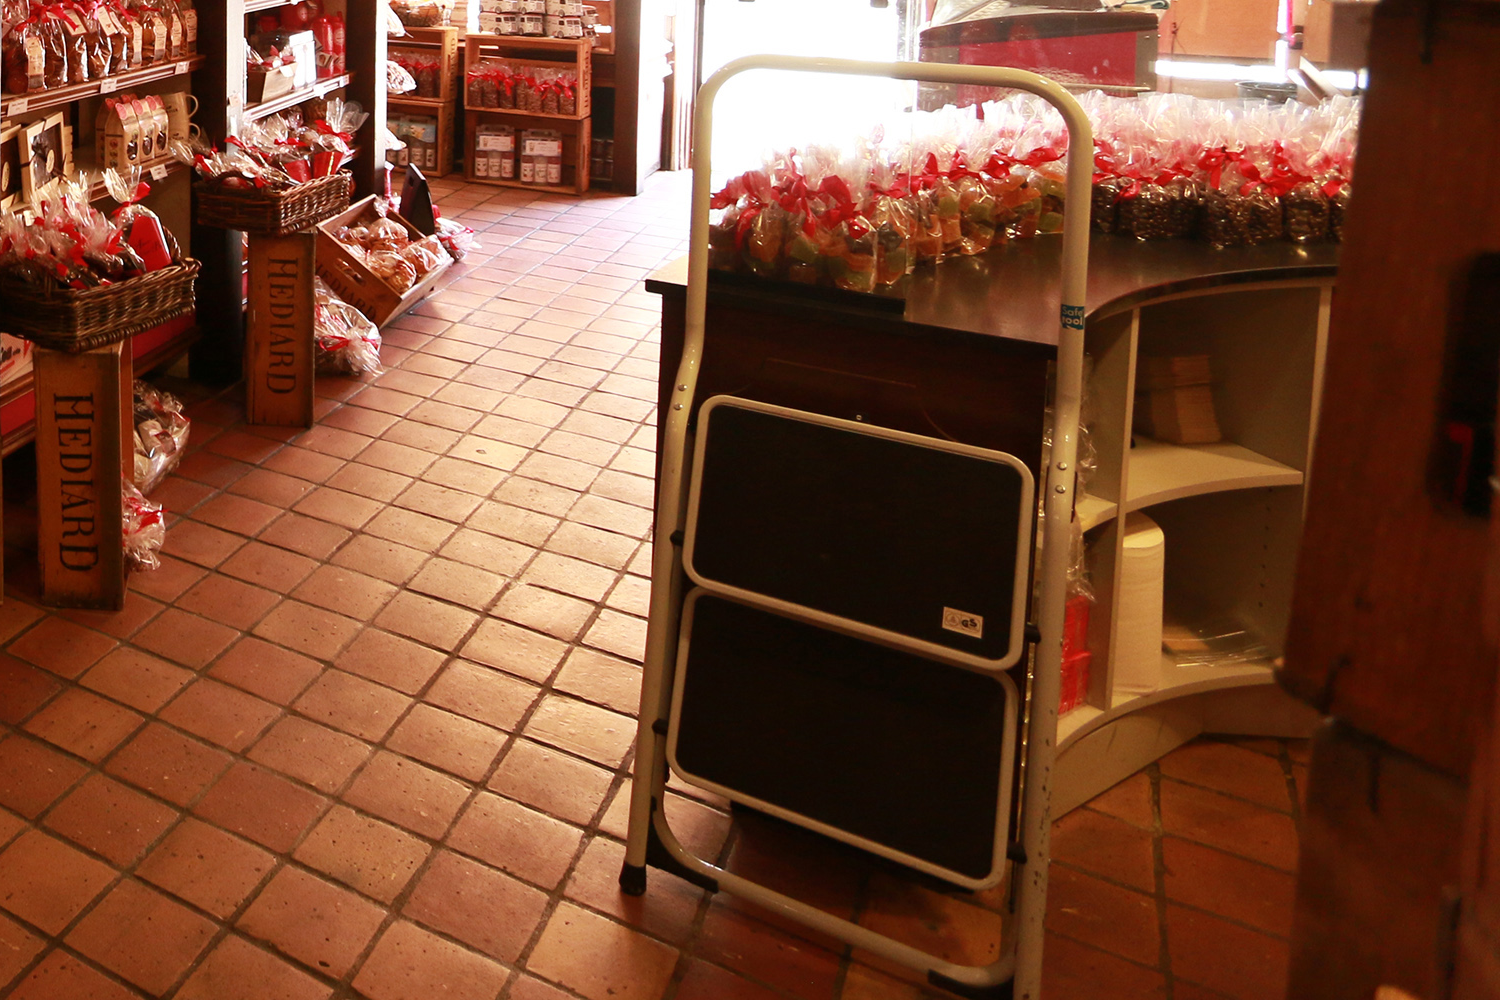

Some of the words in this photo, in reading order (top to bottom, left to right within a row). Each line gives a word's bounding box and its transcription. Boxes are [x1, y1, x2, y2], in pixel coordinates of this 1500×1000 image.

[1062, 306, 1083, 316] Safe
[1062, 315, 1083, 325] tool
[266, 258, 299, 395] HEDIARD
[53, 392, 99, 572] HEDIARD
[961, 618, 977, 628] GS
